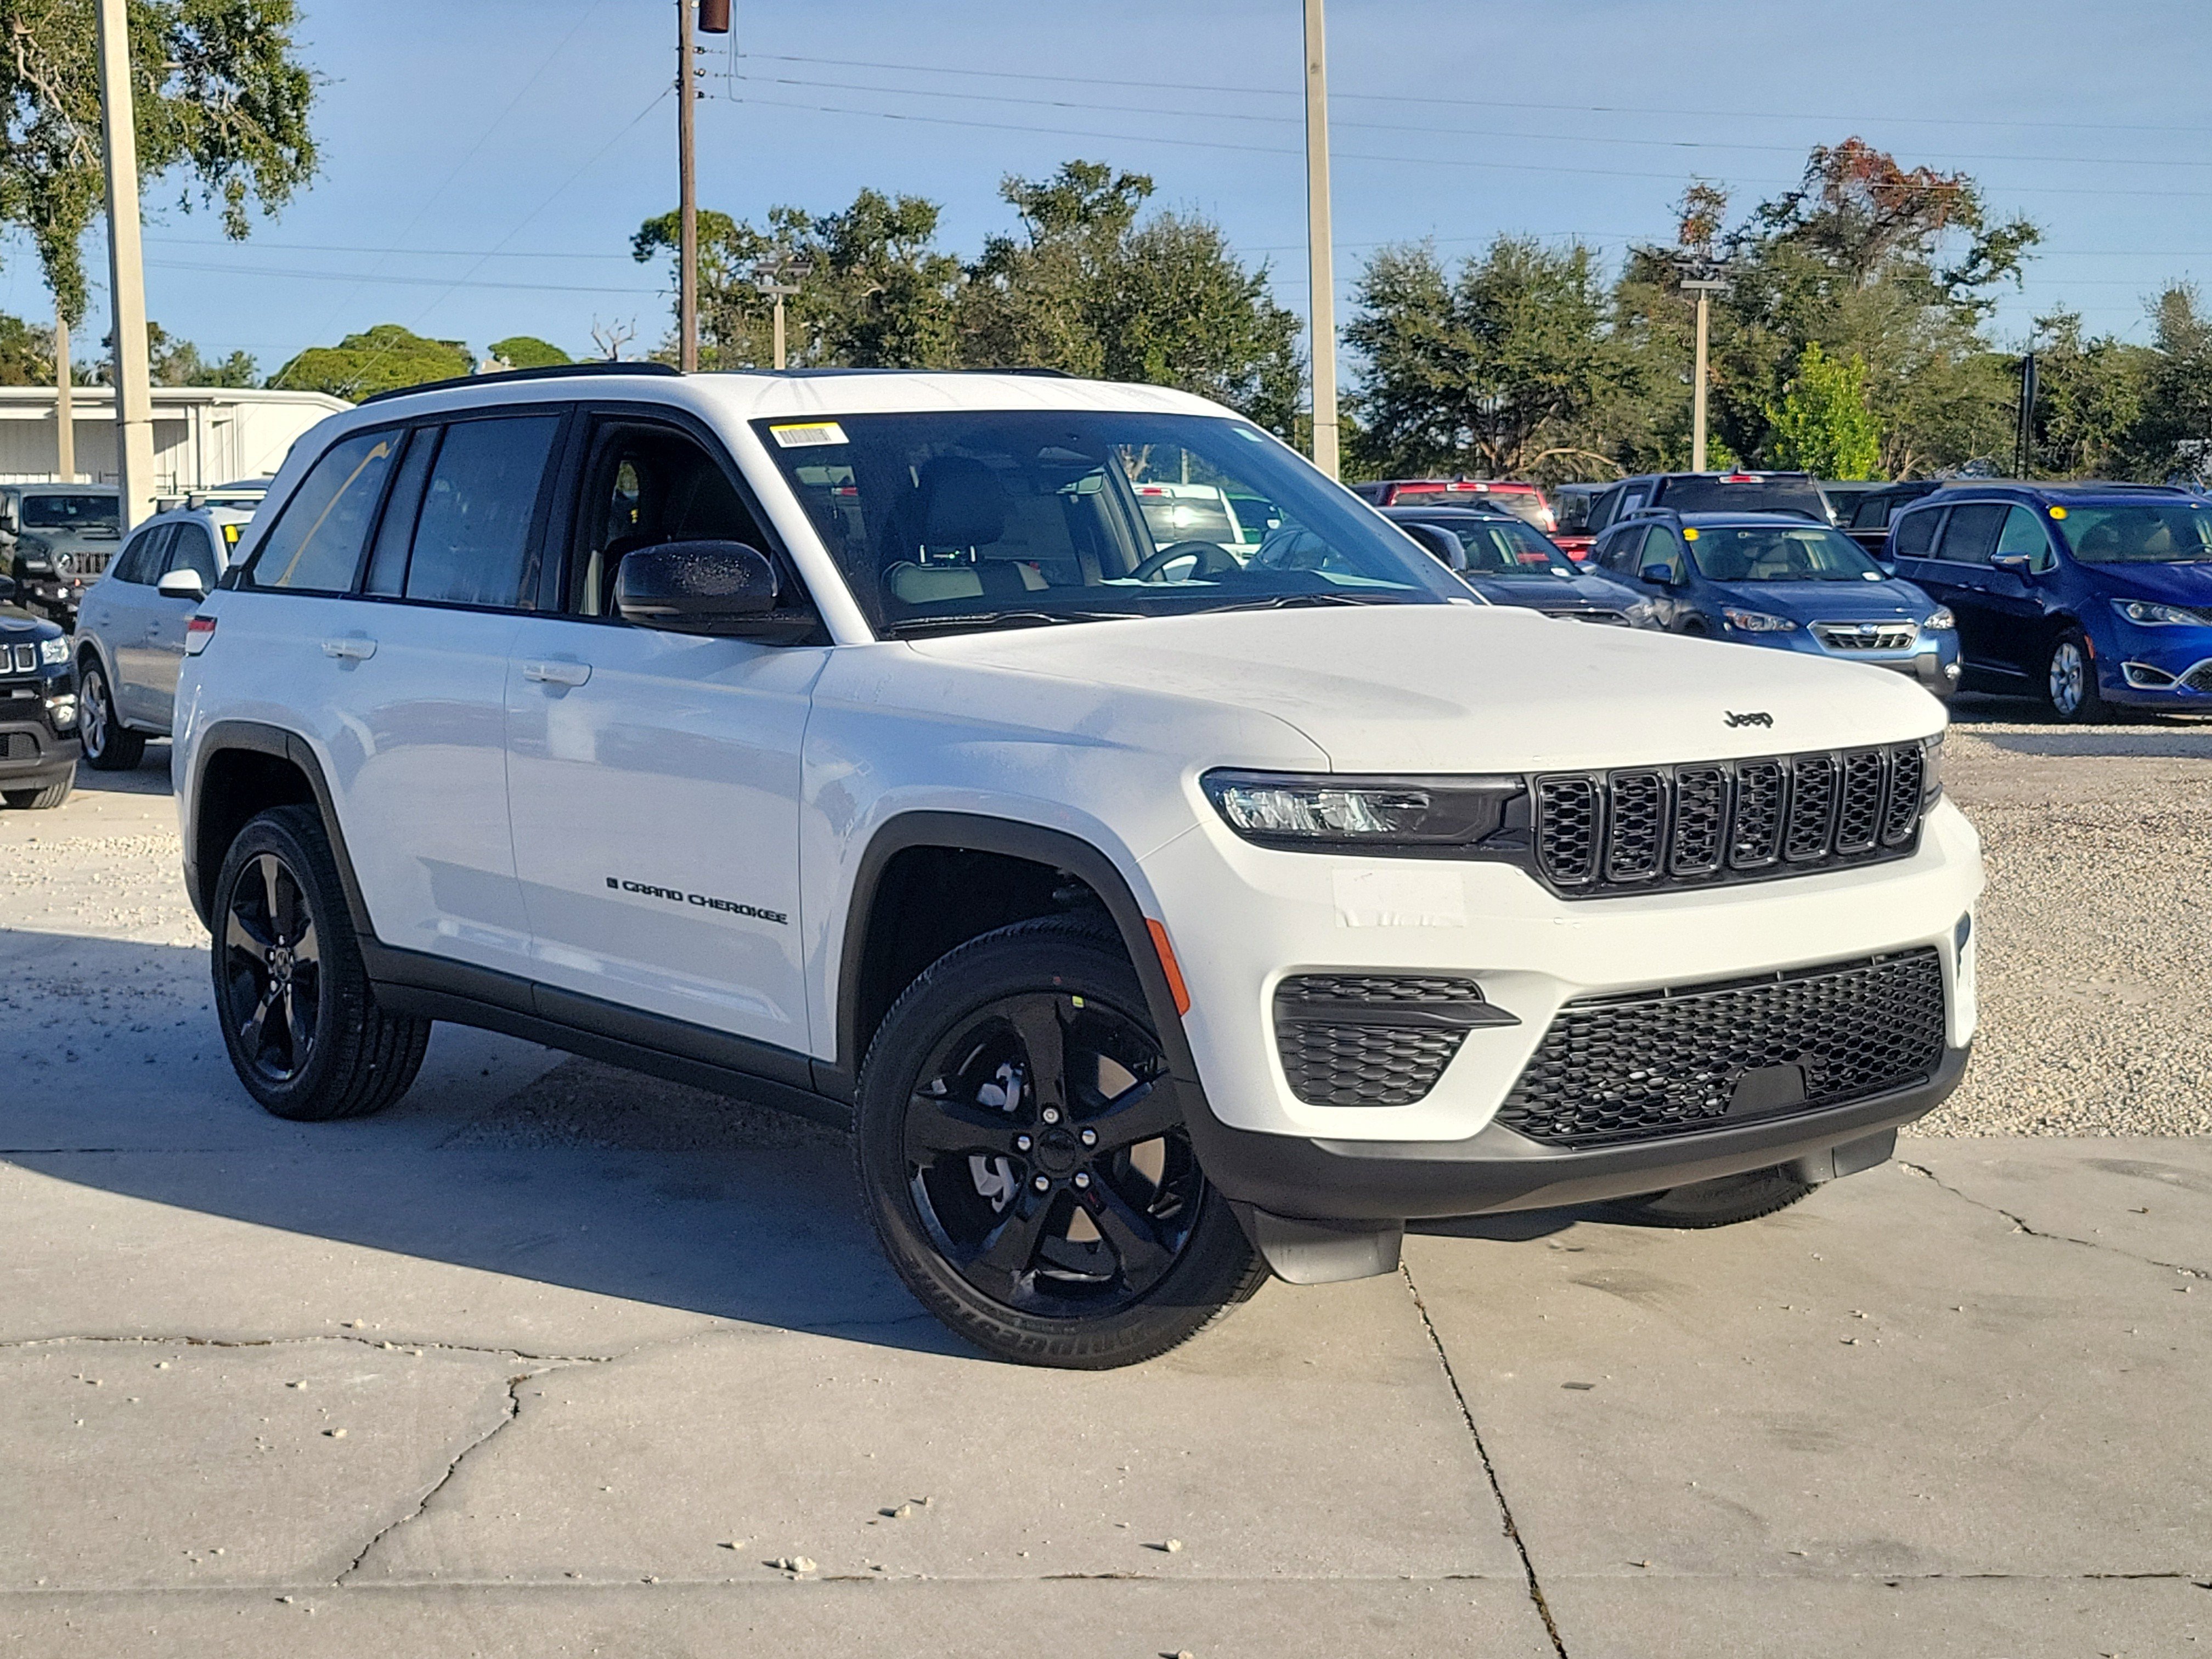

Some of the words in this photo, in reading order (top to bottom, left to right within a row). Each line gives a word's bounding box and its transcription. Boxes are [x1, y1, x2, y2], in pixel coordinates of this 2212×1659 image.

[1724, 710, 1774, 729] Jeep
[622, 881, 684, 901] GRAND
[688, 894, 788, 925] CHEROKEE
